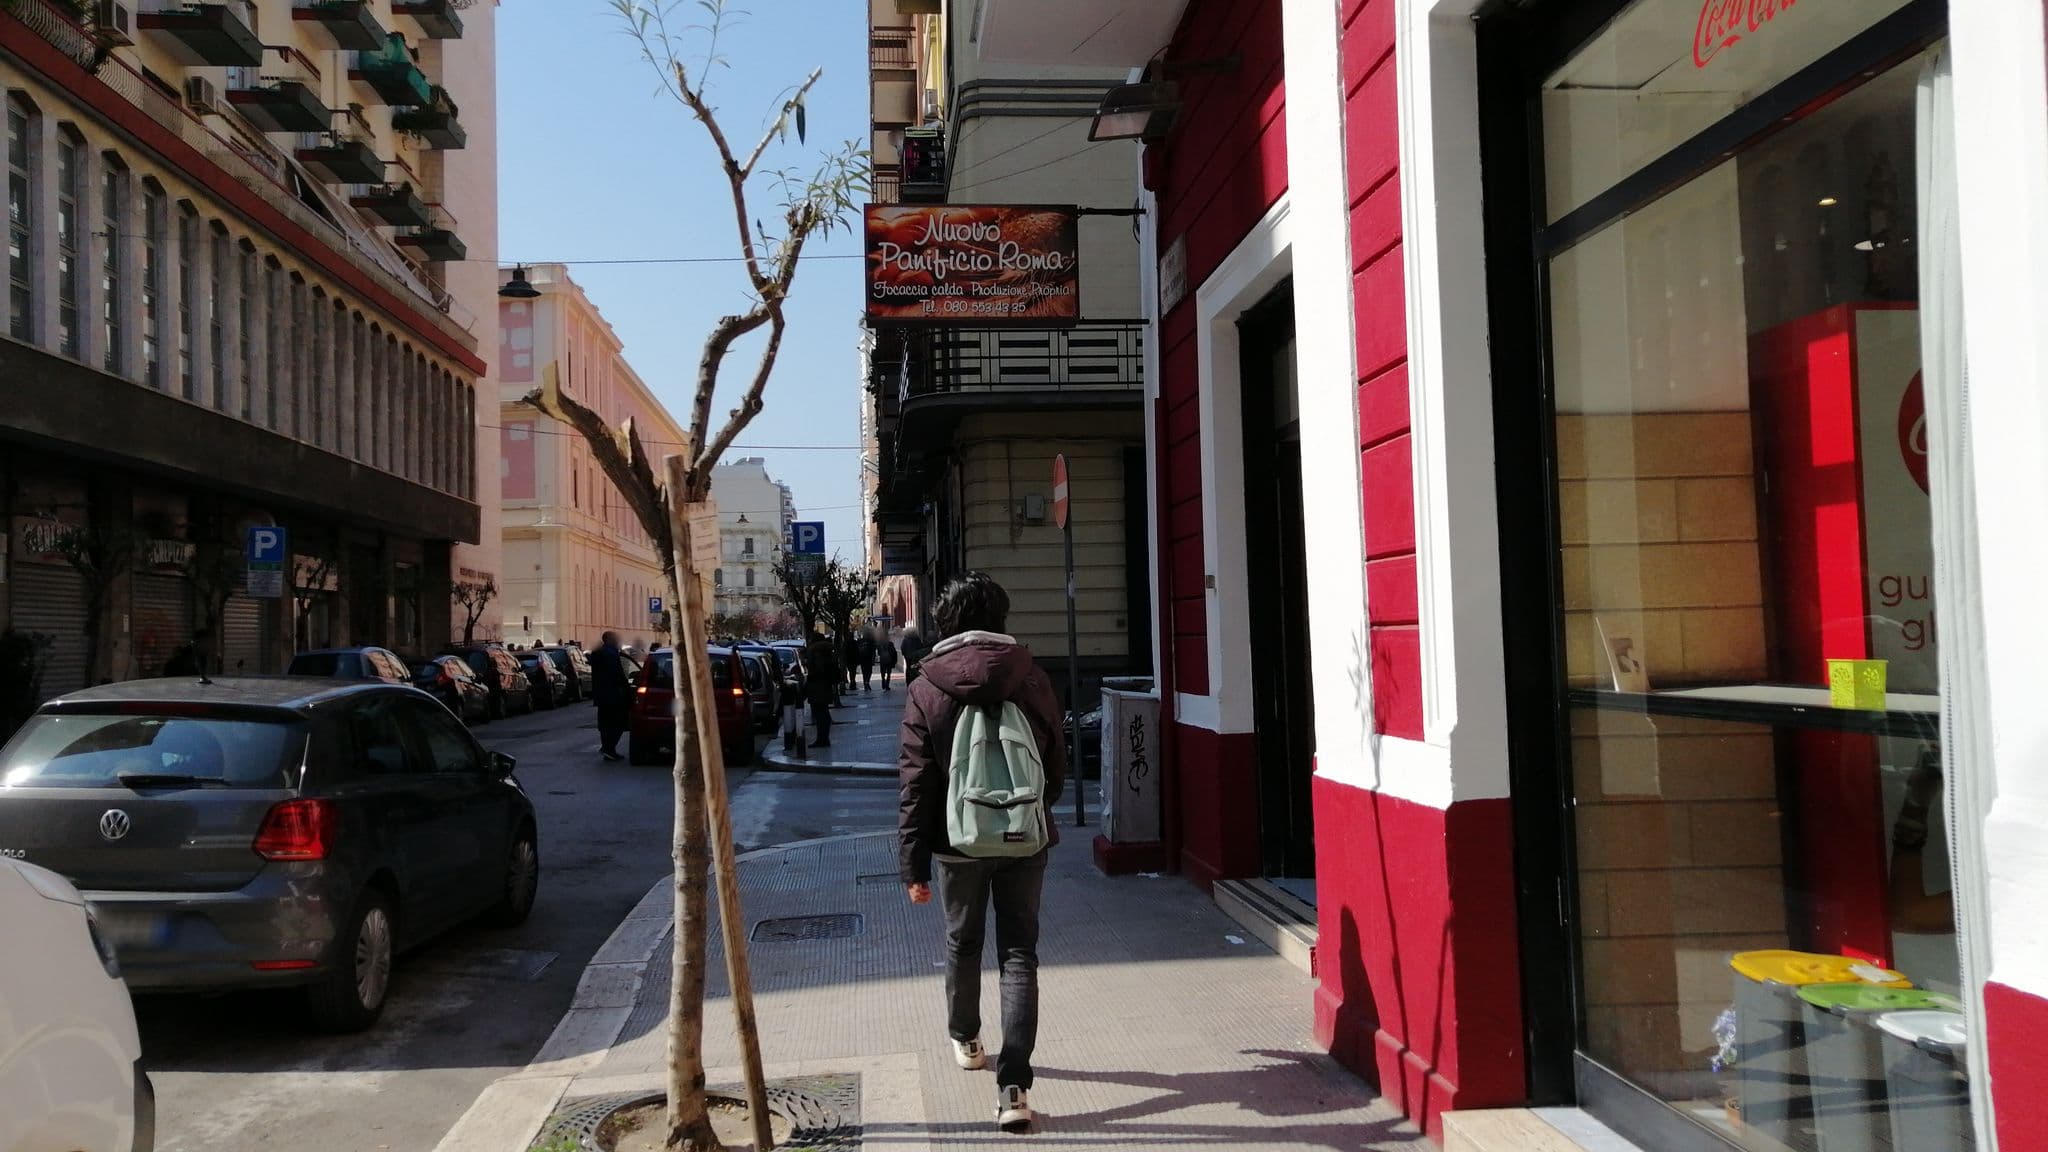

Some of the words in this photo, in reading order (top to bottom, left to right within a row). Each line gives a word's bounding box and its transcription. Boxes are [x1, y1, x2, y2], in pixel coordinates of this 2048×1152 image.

[914, 212, 1001, 246] Nuovo
[878, 241, 992, 279] Panificio
[998, 240, 1064, 272] Roma
[873, 281, 929, 299] Focaccia
[931, 281, 964, 297] calda
[972, 282, 1027, 297] Produzione
[1031, 282, 1071, 298] Propria
[919, 300, 939, 314] Tel.
[943, 300, 968, 313] 080
[971, 301, 992, 313] 553
[995, 301, 1010, 313] 43
[1011, 301, 1027, 313] 35
[254, 530, 278, 559] P
[799, 525, 818, 551] P
[651, 598, 661, 610] P
[1879, 575, 1928, 607] gu
[1901, 610, 1936, 650] gl
